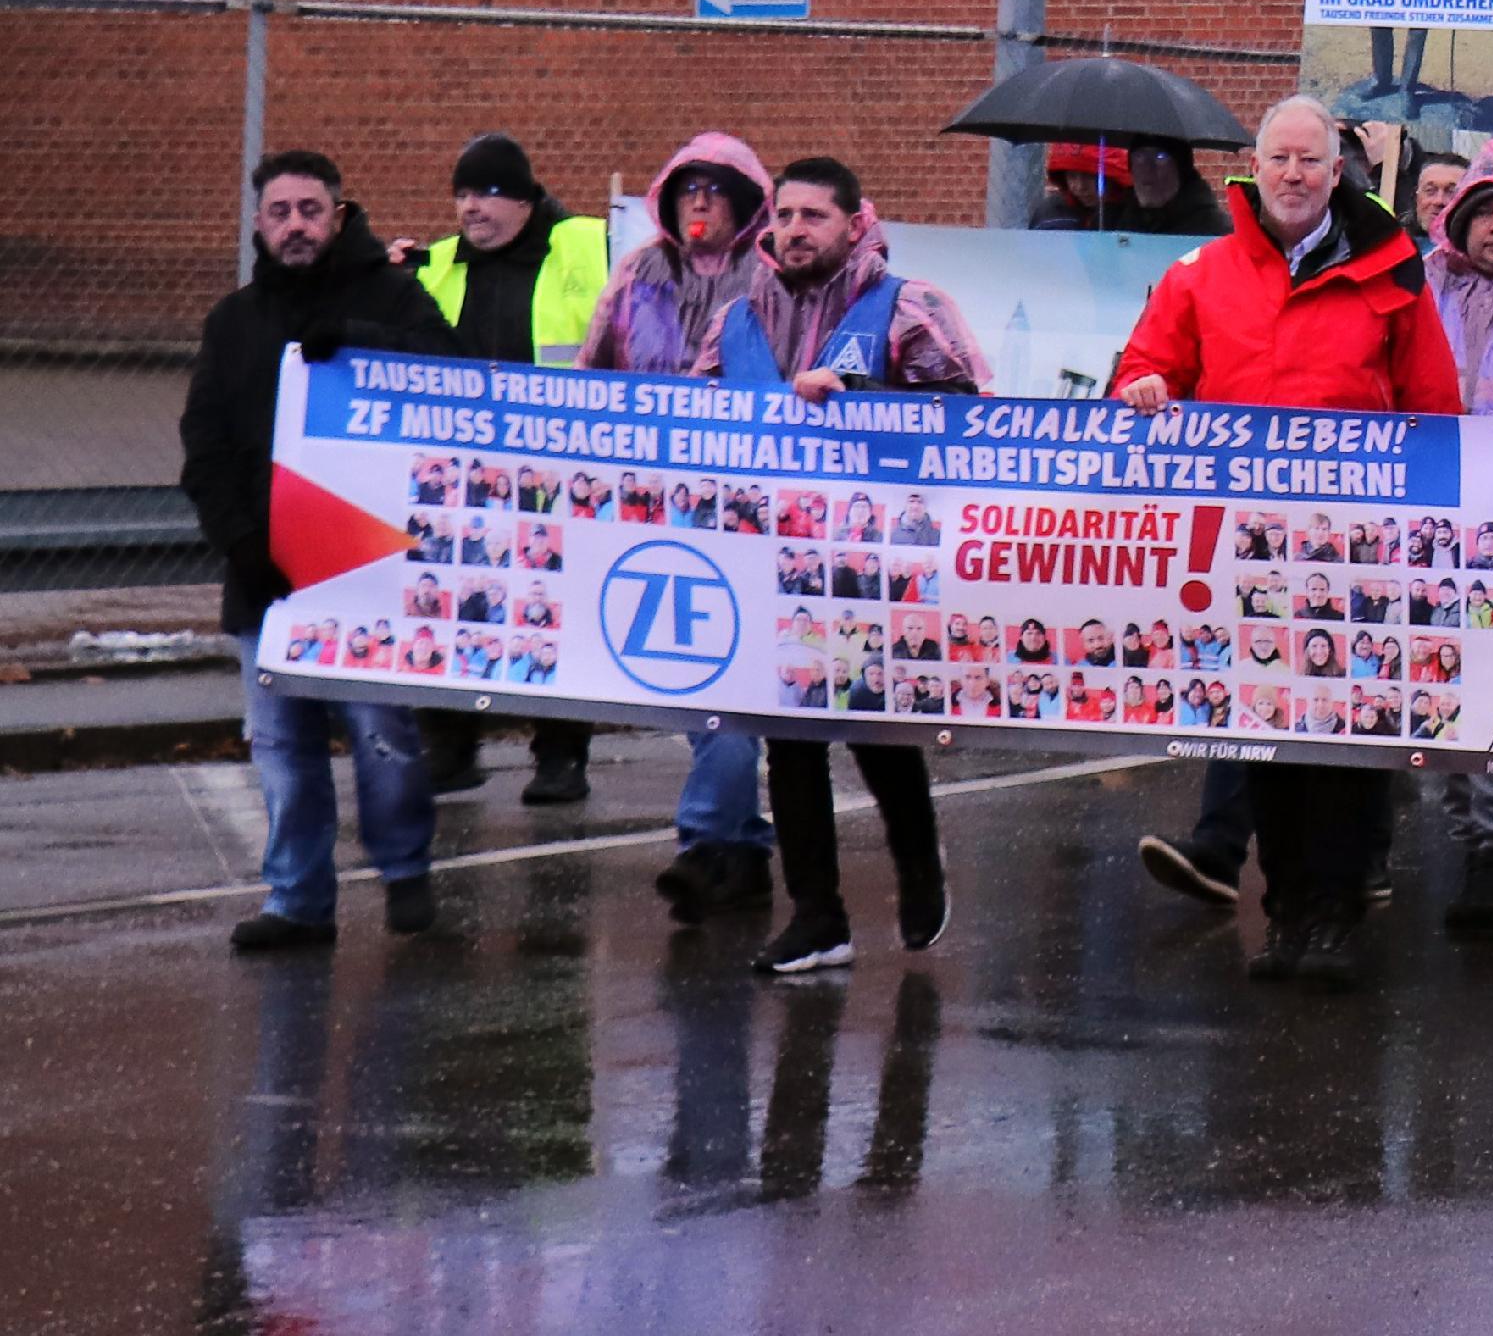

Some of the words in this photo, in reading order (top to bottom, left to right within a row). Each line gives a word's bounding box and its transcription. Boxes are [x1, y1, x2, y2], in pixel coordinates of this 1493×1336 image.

[350, 358, 485, 400] TAUSEND
[491, 370, 627, 413] FREUNDE
[634, 383, 754, 422] STEHEN
[762, 392, 946, 435] ZUSAMMEN
[963, 404, 1136, 444] SCHALKE
[1147, 411, 1253, 448] MUSS
[1266, 414, 1407, 455] LEBEN!
[347, 399, 392, 436] ZF
[401, 403, 495, 445] MUSS
[503, 413, 659, 461] ZUSAGEN
[669, 428, 869, 475] EINHALTEN
[918, 444, 1217, 491] ARBEITSPLÄTZE
[1228, 456, 1407, 498] SICHERN!
[959, 503, 1183, 542] SOLIDARITÄT
[1178, 740, 1207, 759] WIR
[1209, 742, 1238, 760] FÜR
[1239, 744, 1278, 762] NRW
